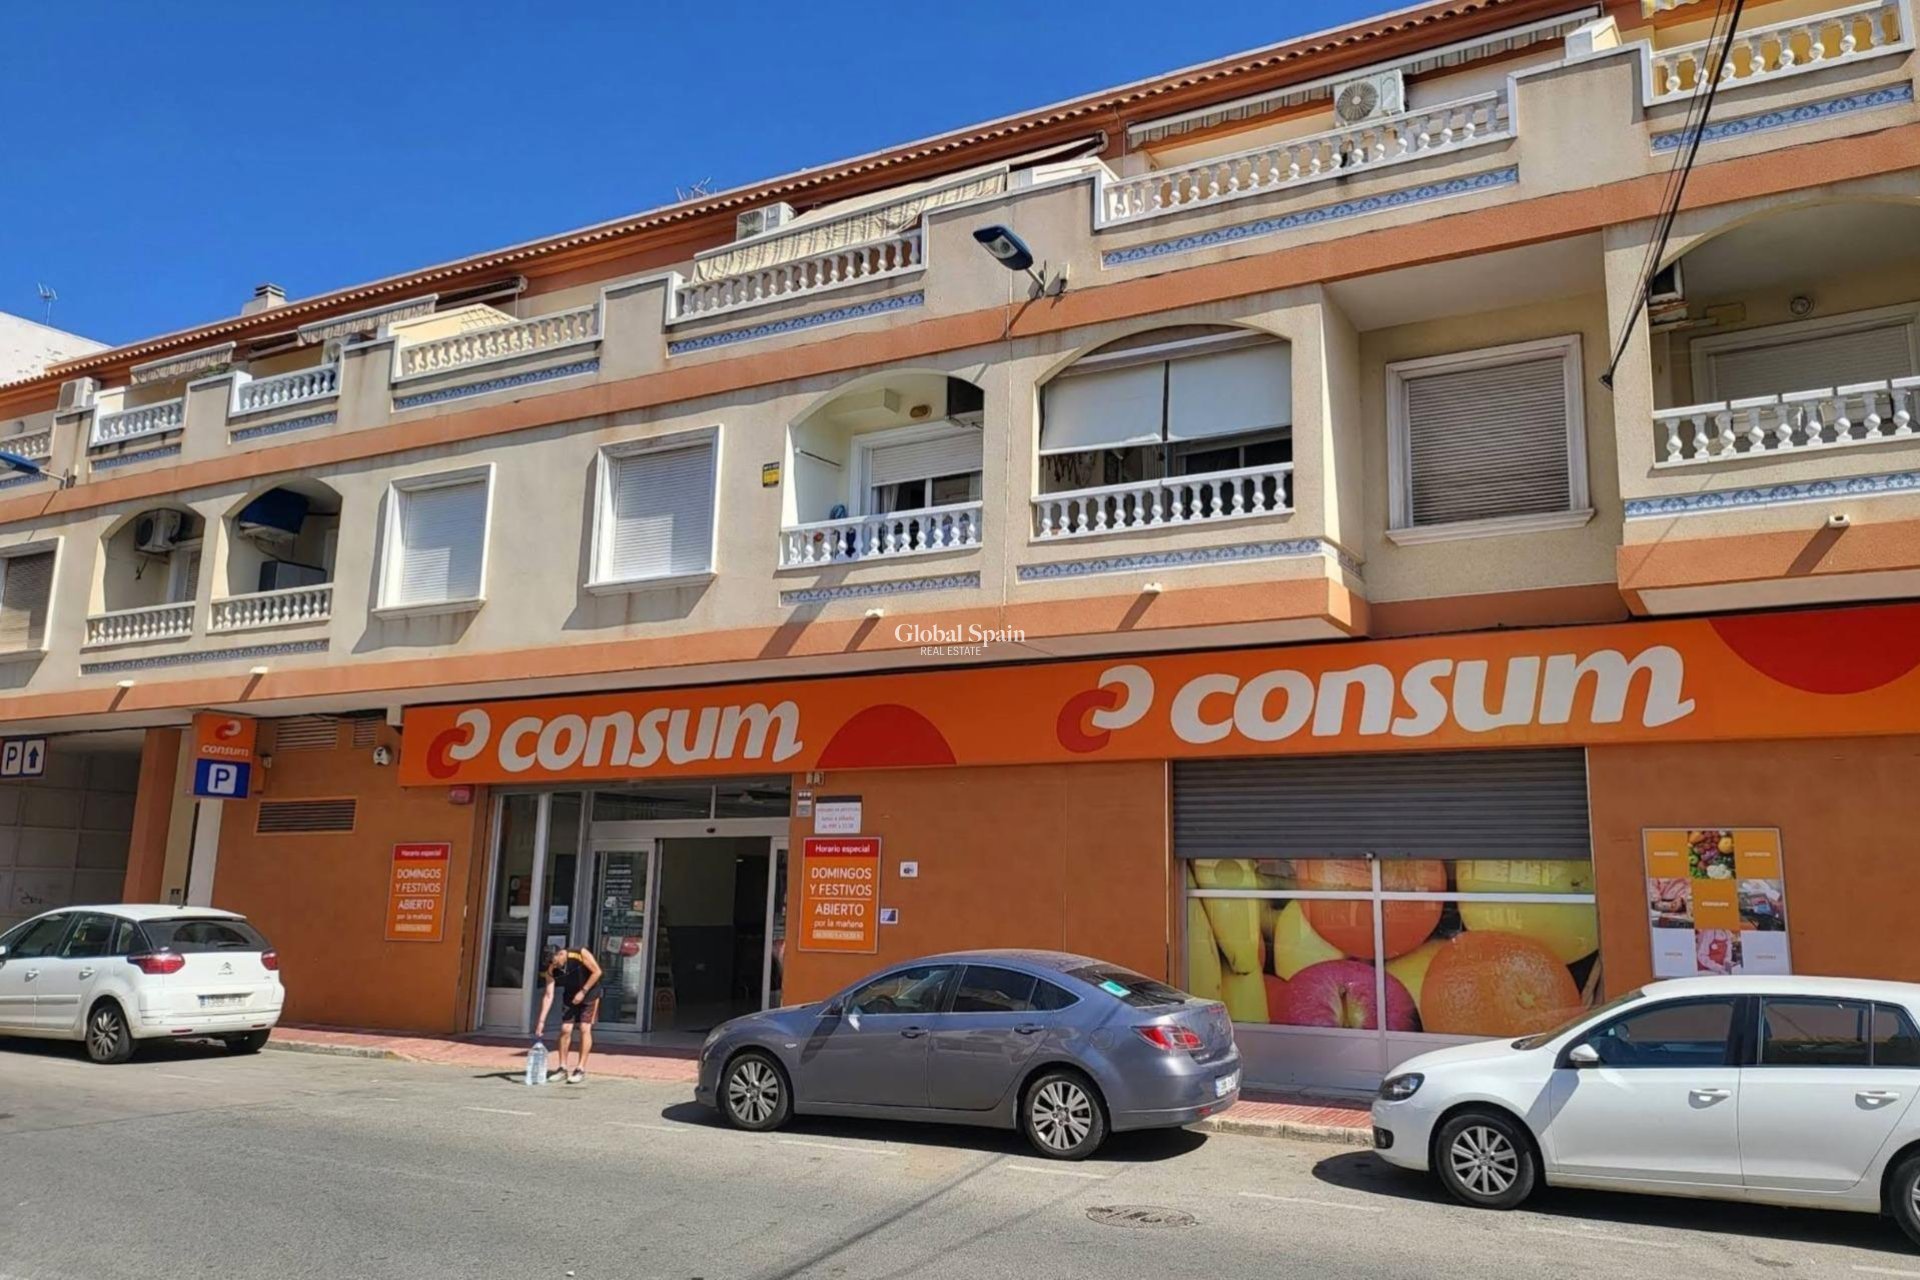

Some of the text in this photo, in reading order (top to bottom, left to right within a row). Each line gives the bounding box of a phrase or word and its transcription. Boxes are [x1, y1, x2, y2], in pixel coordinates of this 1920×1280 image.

[1170, 645, 1696, 744] consum
[498, 700, 803, 773] consum
[202, 744, 249, 757] consum
[6, 746, 18, 770] P
[214, 768, 230, 789] P
[815, 844, 870, 855] Horario especial
[397, 868, 441, 879] DOMINGOS
[811, 867, 872, 879] DOMINGOS
[395, 883, 440, 893] Y FESTIVOS
[809, 884, 872, 896] Y FESTIVOS
[398, 899, 434, 910] ABIERTO
[815, 903, 864, 916] ABIERTO
[814, 918, 863, 929] por la mañana
